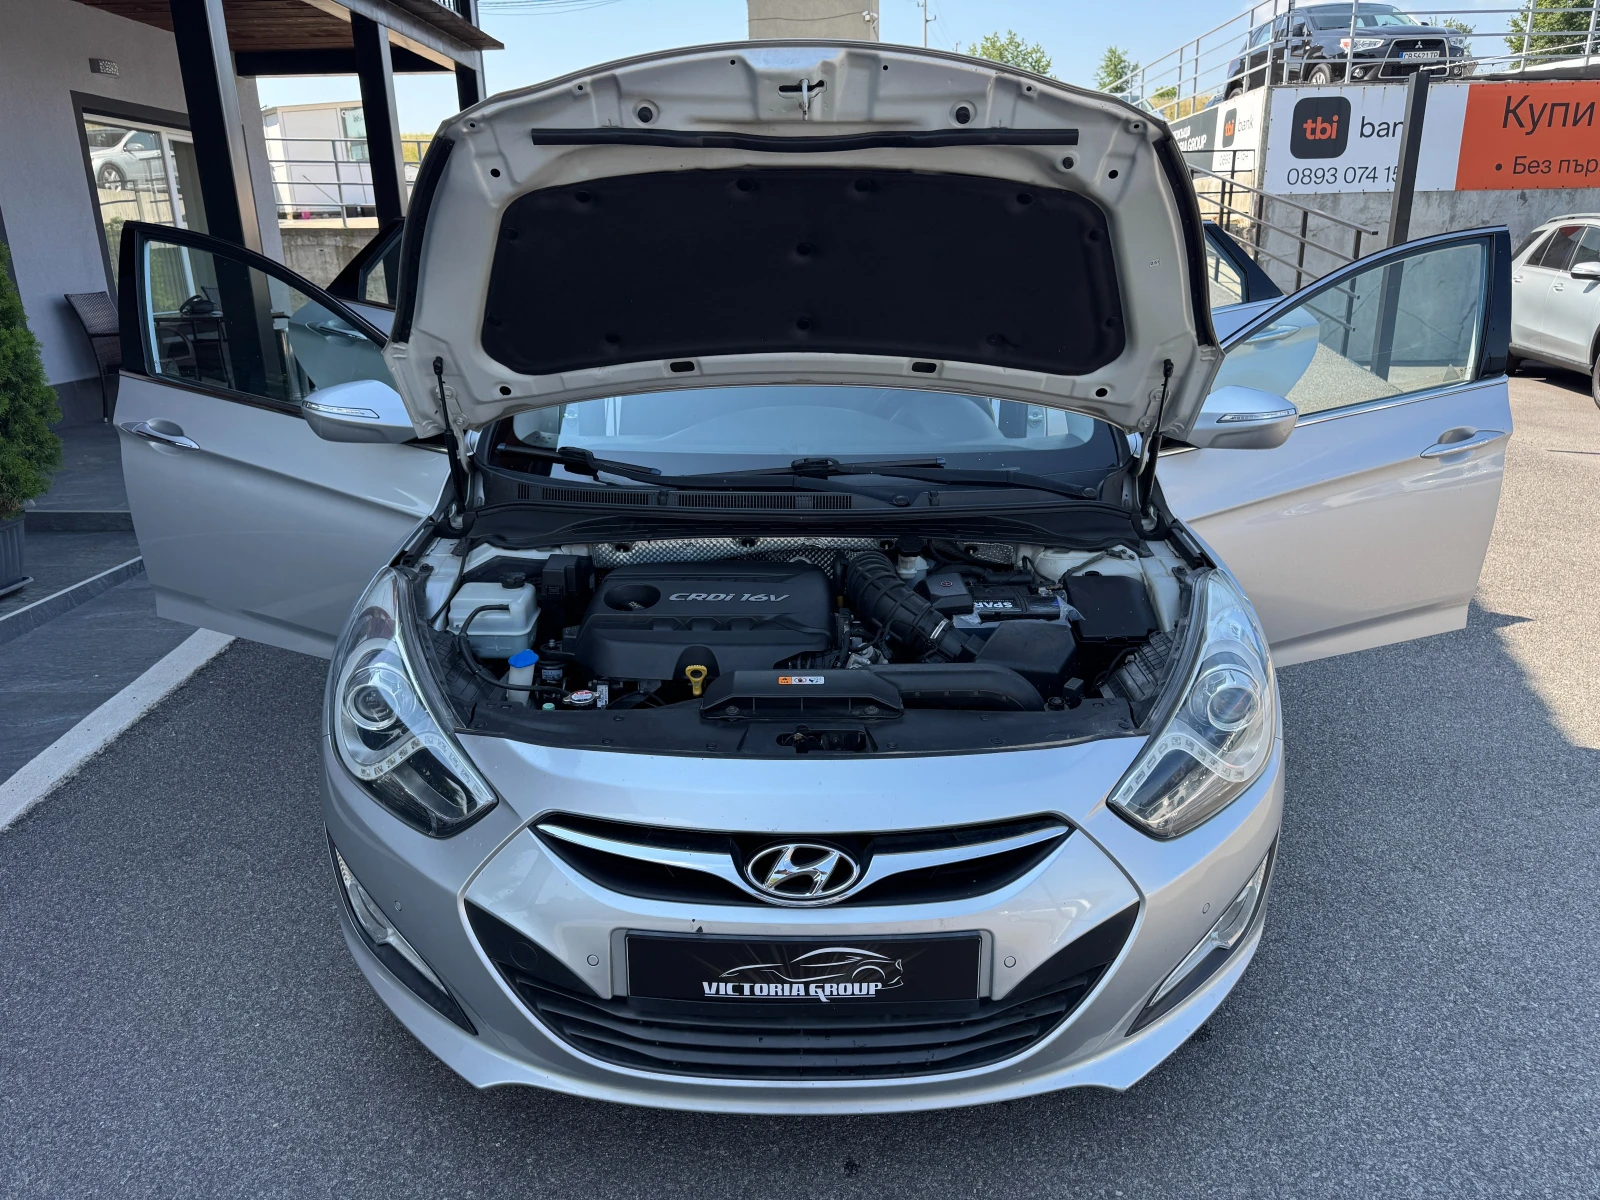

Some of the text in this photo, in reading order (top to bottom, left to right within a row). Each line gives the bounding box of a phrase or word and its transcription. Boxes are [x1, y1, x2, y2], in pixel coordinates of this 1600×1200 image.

[1237, 114, 1254, 132] bank
[1502, 94, 1595, 135] Купи
[1303, 115, 1404, 139] tbi ban
[1287, 166, 1398, 185] 0893 074 15
[1513, 155, 1600, 177] Без пър
[668, 592, 790, 602] CRDi 16V
[702, 981, 883, 1002] VICTORIA GROUP
